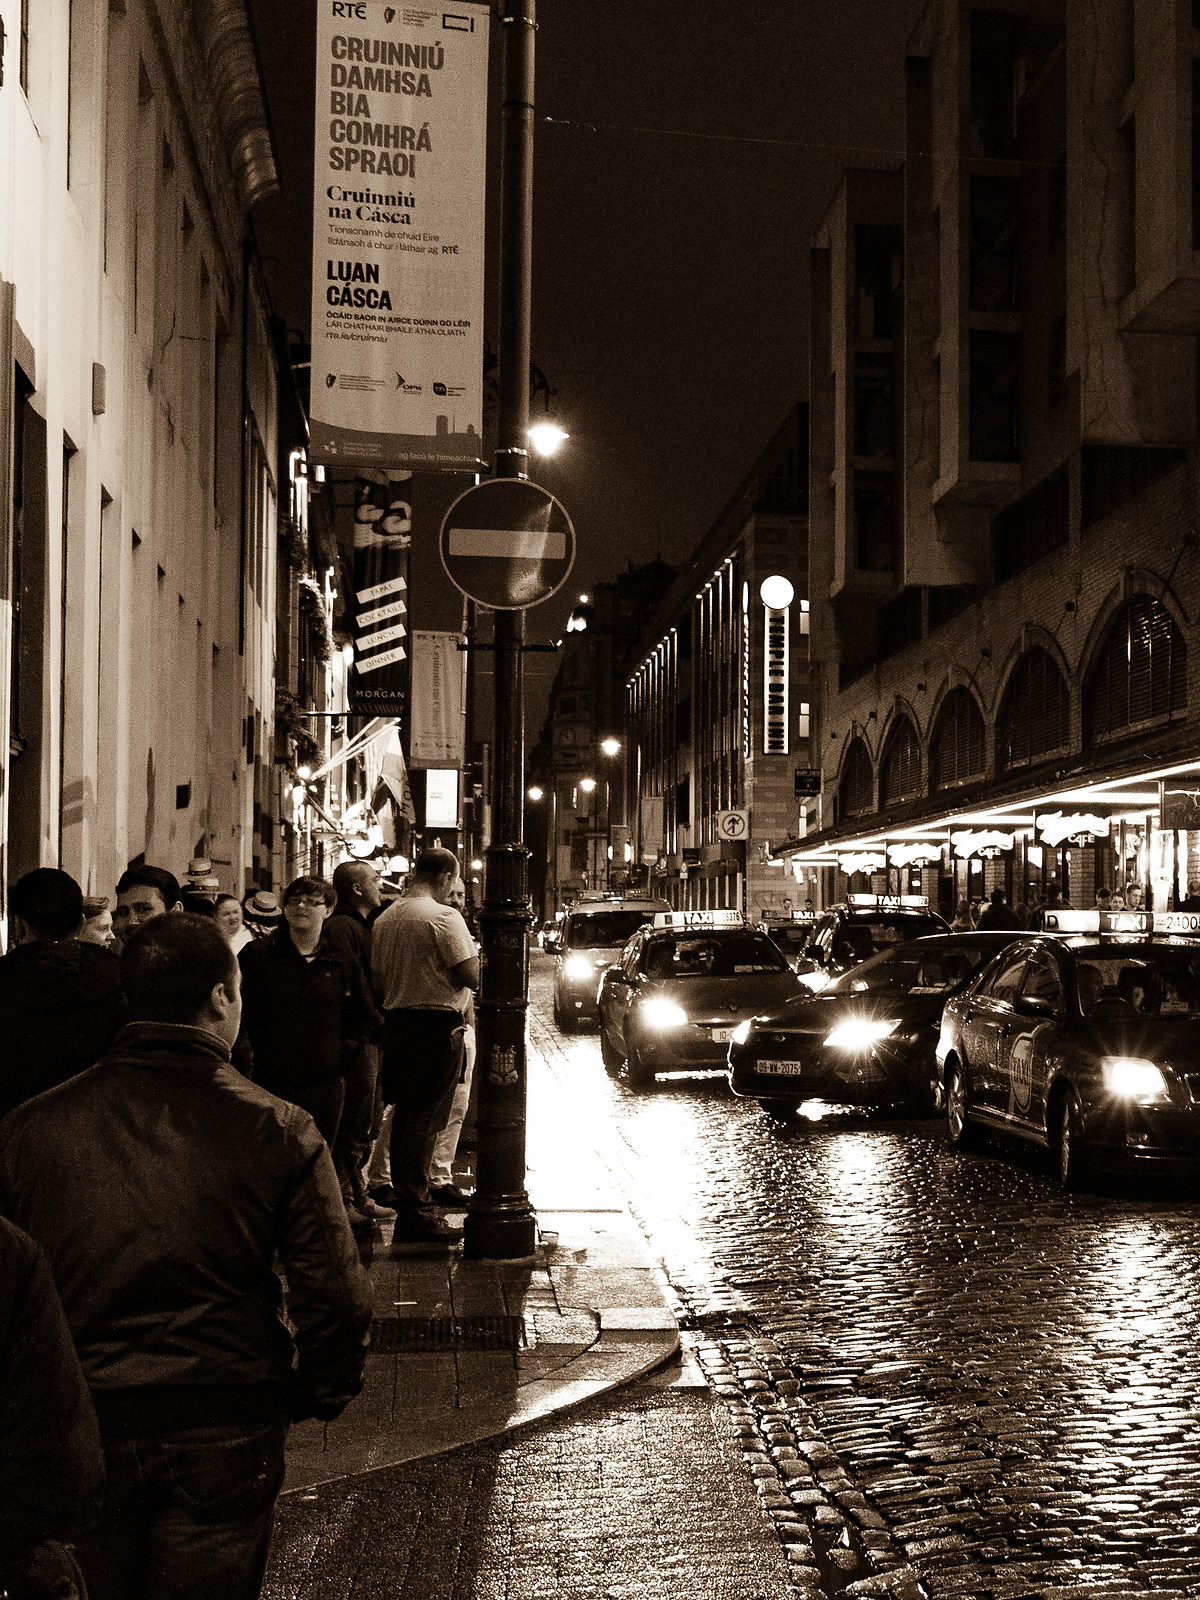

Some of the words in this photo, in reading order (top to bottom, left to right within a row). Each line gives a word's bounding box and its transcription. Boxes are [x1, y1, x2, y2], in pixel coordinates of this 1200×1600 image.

[331, 35, 445, 70] CRUINNIÚ
[330, 64, 432, 98] DAMHSA
[330, 91, 371, 118] BIA
[329, 119, 432, 152] COMHRÁ
[328, 146, 416, 178] SPRAOI
[326, 185, 416, 208] Cruinniú
[328, 206, 352, 220] na
[355, 205, 412, 225] Cásca
[384, 230, 396, 238] de
[326, 260, 380, 284] LUAN
[326, 282, 392, 310] CÁSCA
[354, 314, 376, 322] SAOR
[439, 319, 452, 327] GO
[370, 584, 394, 596] TAPAS
[359, 604, 404, 624] COCKTAILS
[366, 630, 395, 645] LUNCH
[768, 616, 785, 677] TEMPLE
[366, 652, 396, 668] DINNER
[356, 690, 405, 699] MORGAN
[768, 683, 785, 716] BAR
[768, 722, 785, 750] INN
[878, 895, 900, 905] TAXI
[685, 912, 713, 924] TAXI
[792, 911, 814, 919] TAXI
[1106, 914, 1147, 930] TAXI
